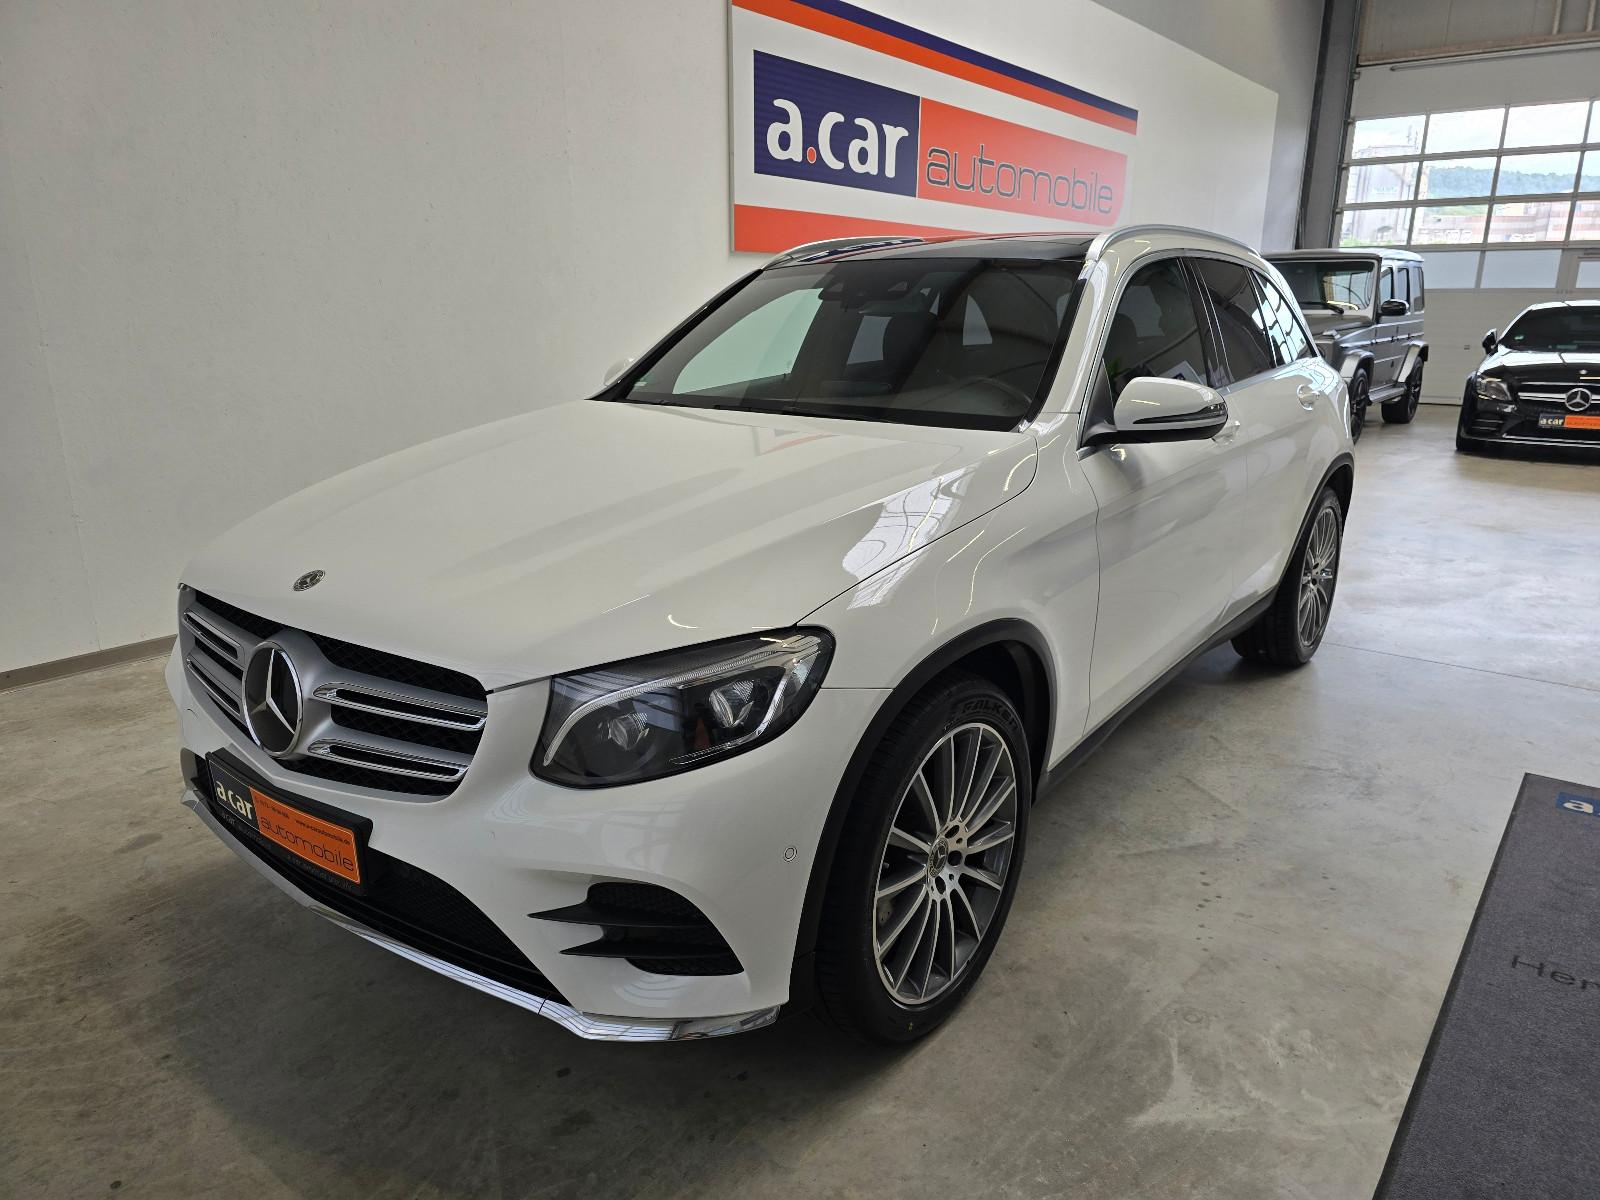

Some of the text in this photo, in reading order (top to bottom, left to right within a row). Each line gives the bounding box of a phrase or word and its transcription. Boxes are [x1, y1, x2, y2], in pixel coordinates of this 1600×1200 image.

[766, 98, 1113, 215] a.car automobile
[260, 816, 354, 871] automobile
